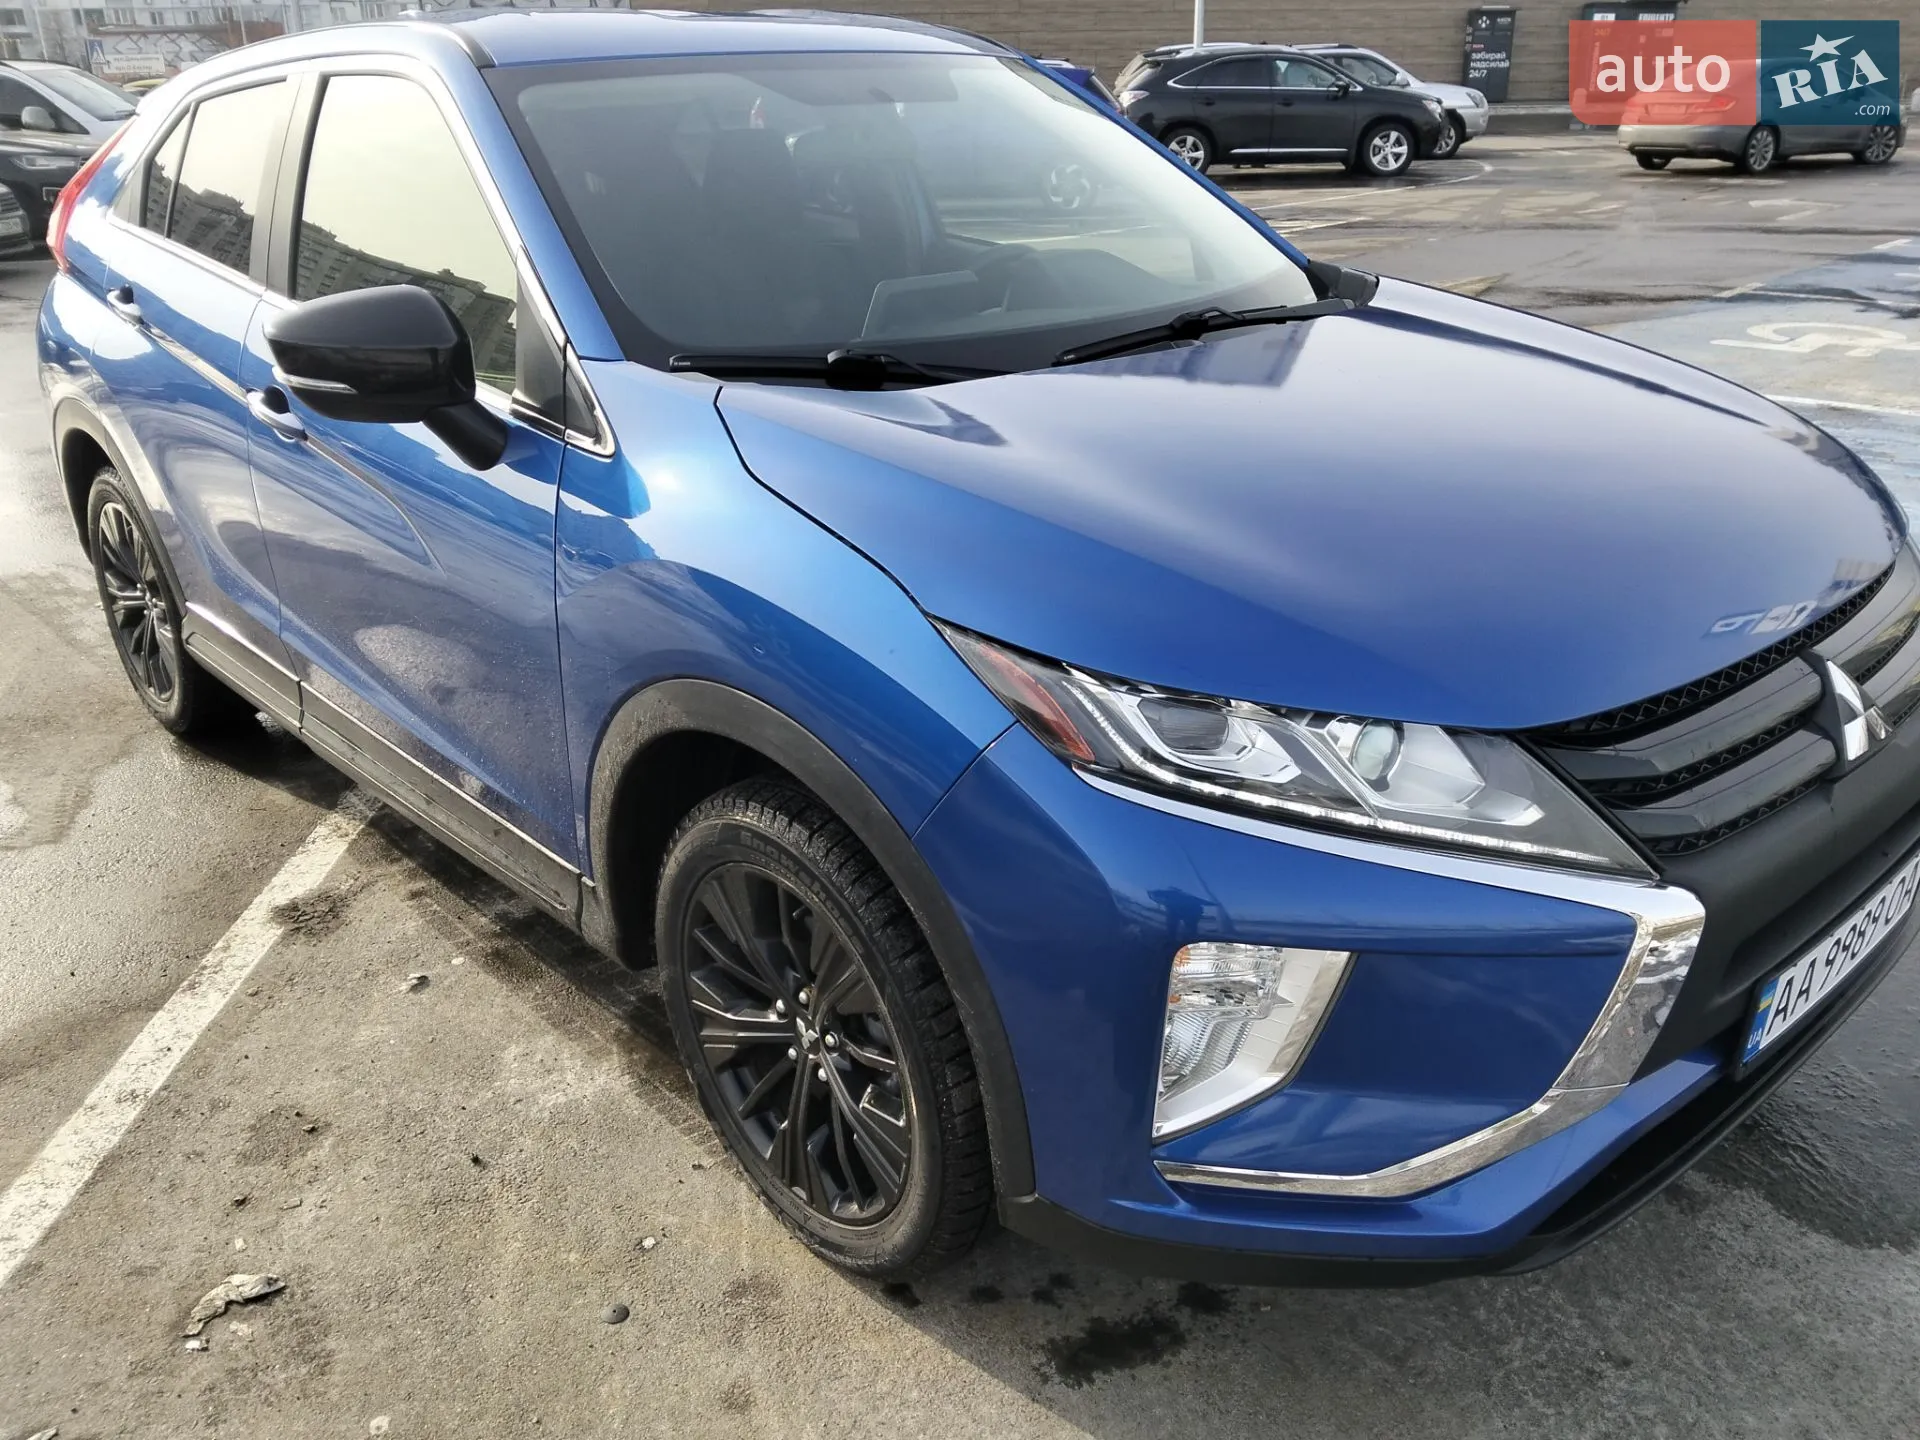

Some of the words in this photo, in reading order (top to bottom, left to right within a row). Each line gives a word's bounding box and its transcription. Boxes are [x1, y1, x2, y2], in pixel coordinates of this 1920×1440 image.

[1471, 51, 1506, 60] забирай
[1470, 60, 1510, 68] надсилай
[1469, 69, 1488, 78] 24/7
[1766, 957, 1817, 1036] AA
[1818, 896, 1886, 993] 9989
[1885, 860, 1919, 925] OA
[1747, 1027, 1763, 1049] UA
